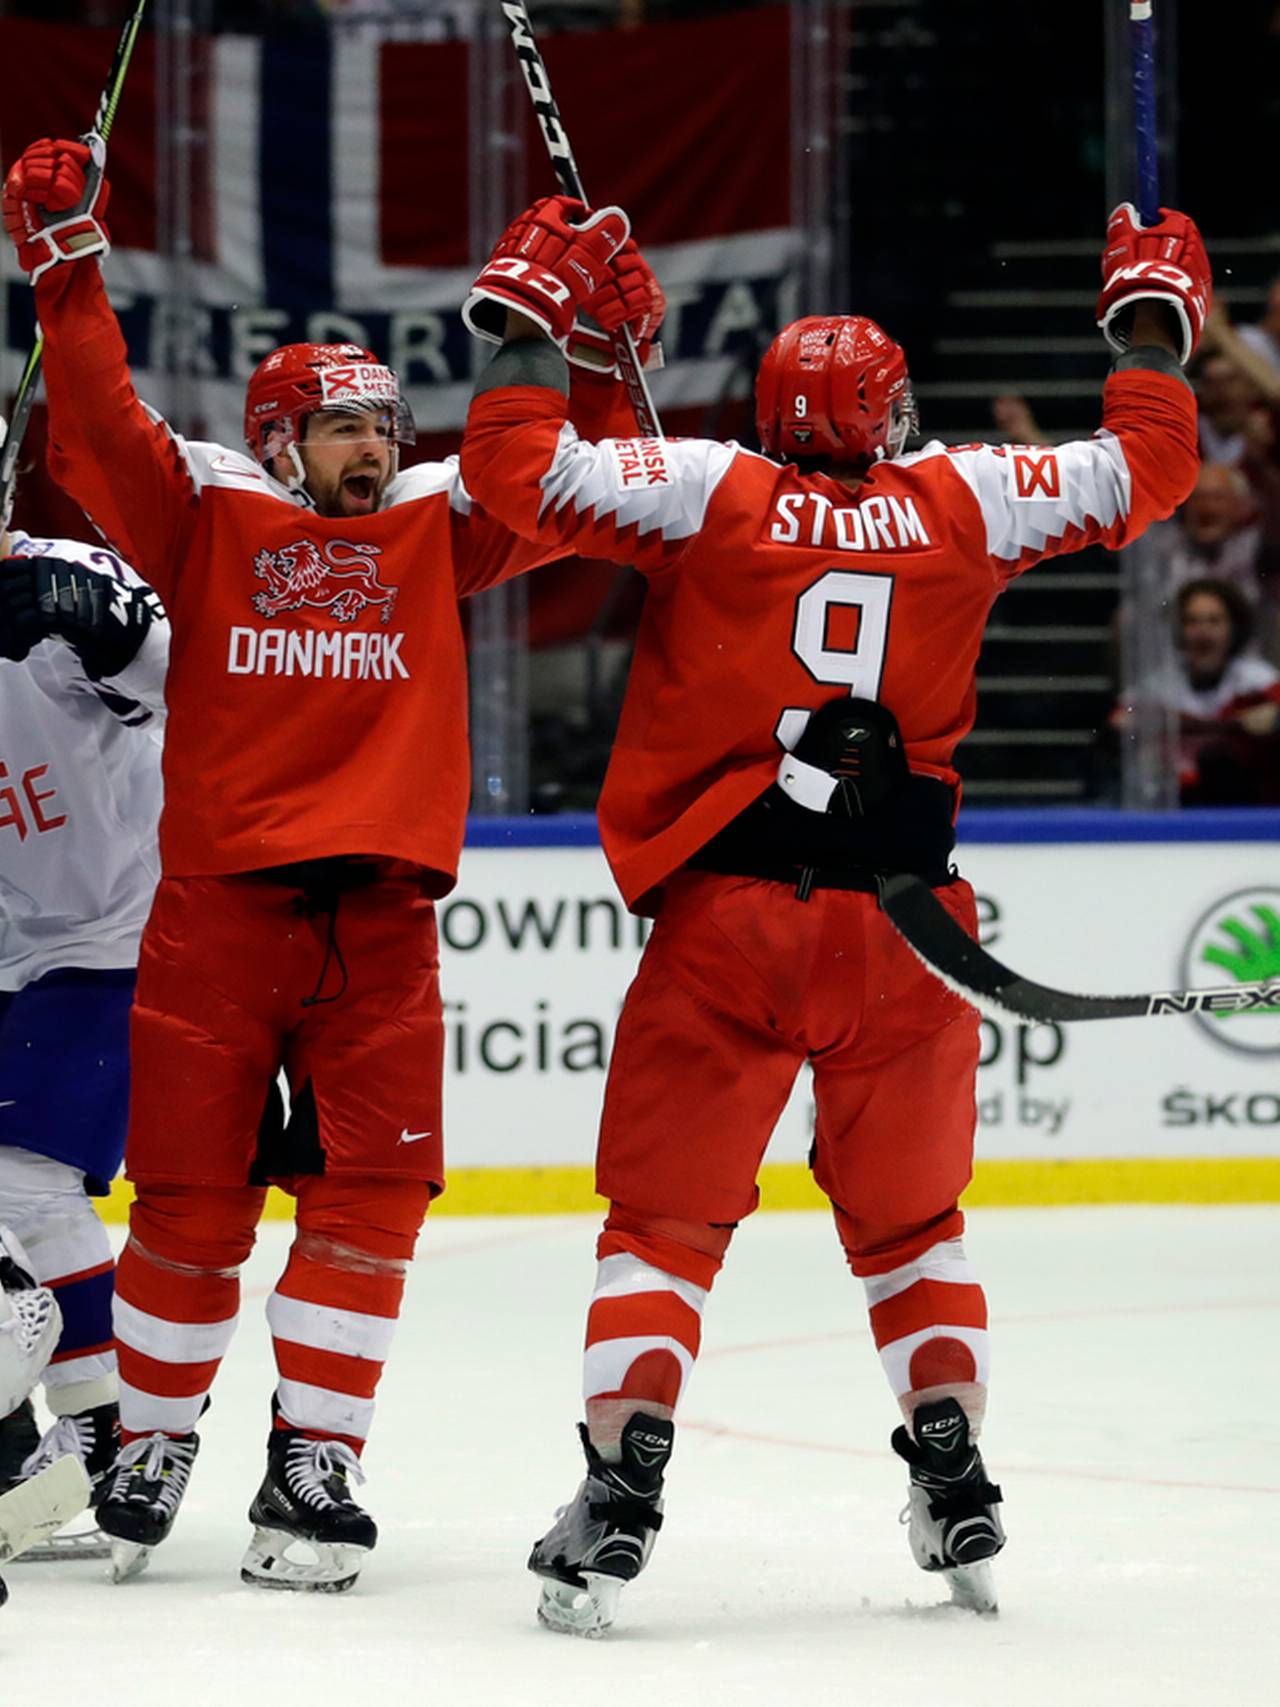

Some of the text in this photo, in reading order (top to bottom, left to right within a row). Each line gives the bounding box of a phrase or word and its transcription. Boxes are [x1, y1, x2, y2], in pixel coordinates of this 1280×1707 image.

[794, 394, 808, 418] 9
[770, 491, 931, 551] STORM
[227, 625, 411, 681] DANMARK
[773, 568, 896, 752] 9
[921, 1414, 962, 1434] CCM
[630, 1430, 671, 1448] CCM
[272, 1486, 295, 1513] CCM
